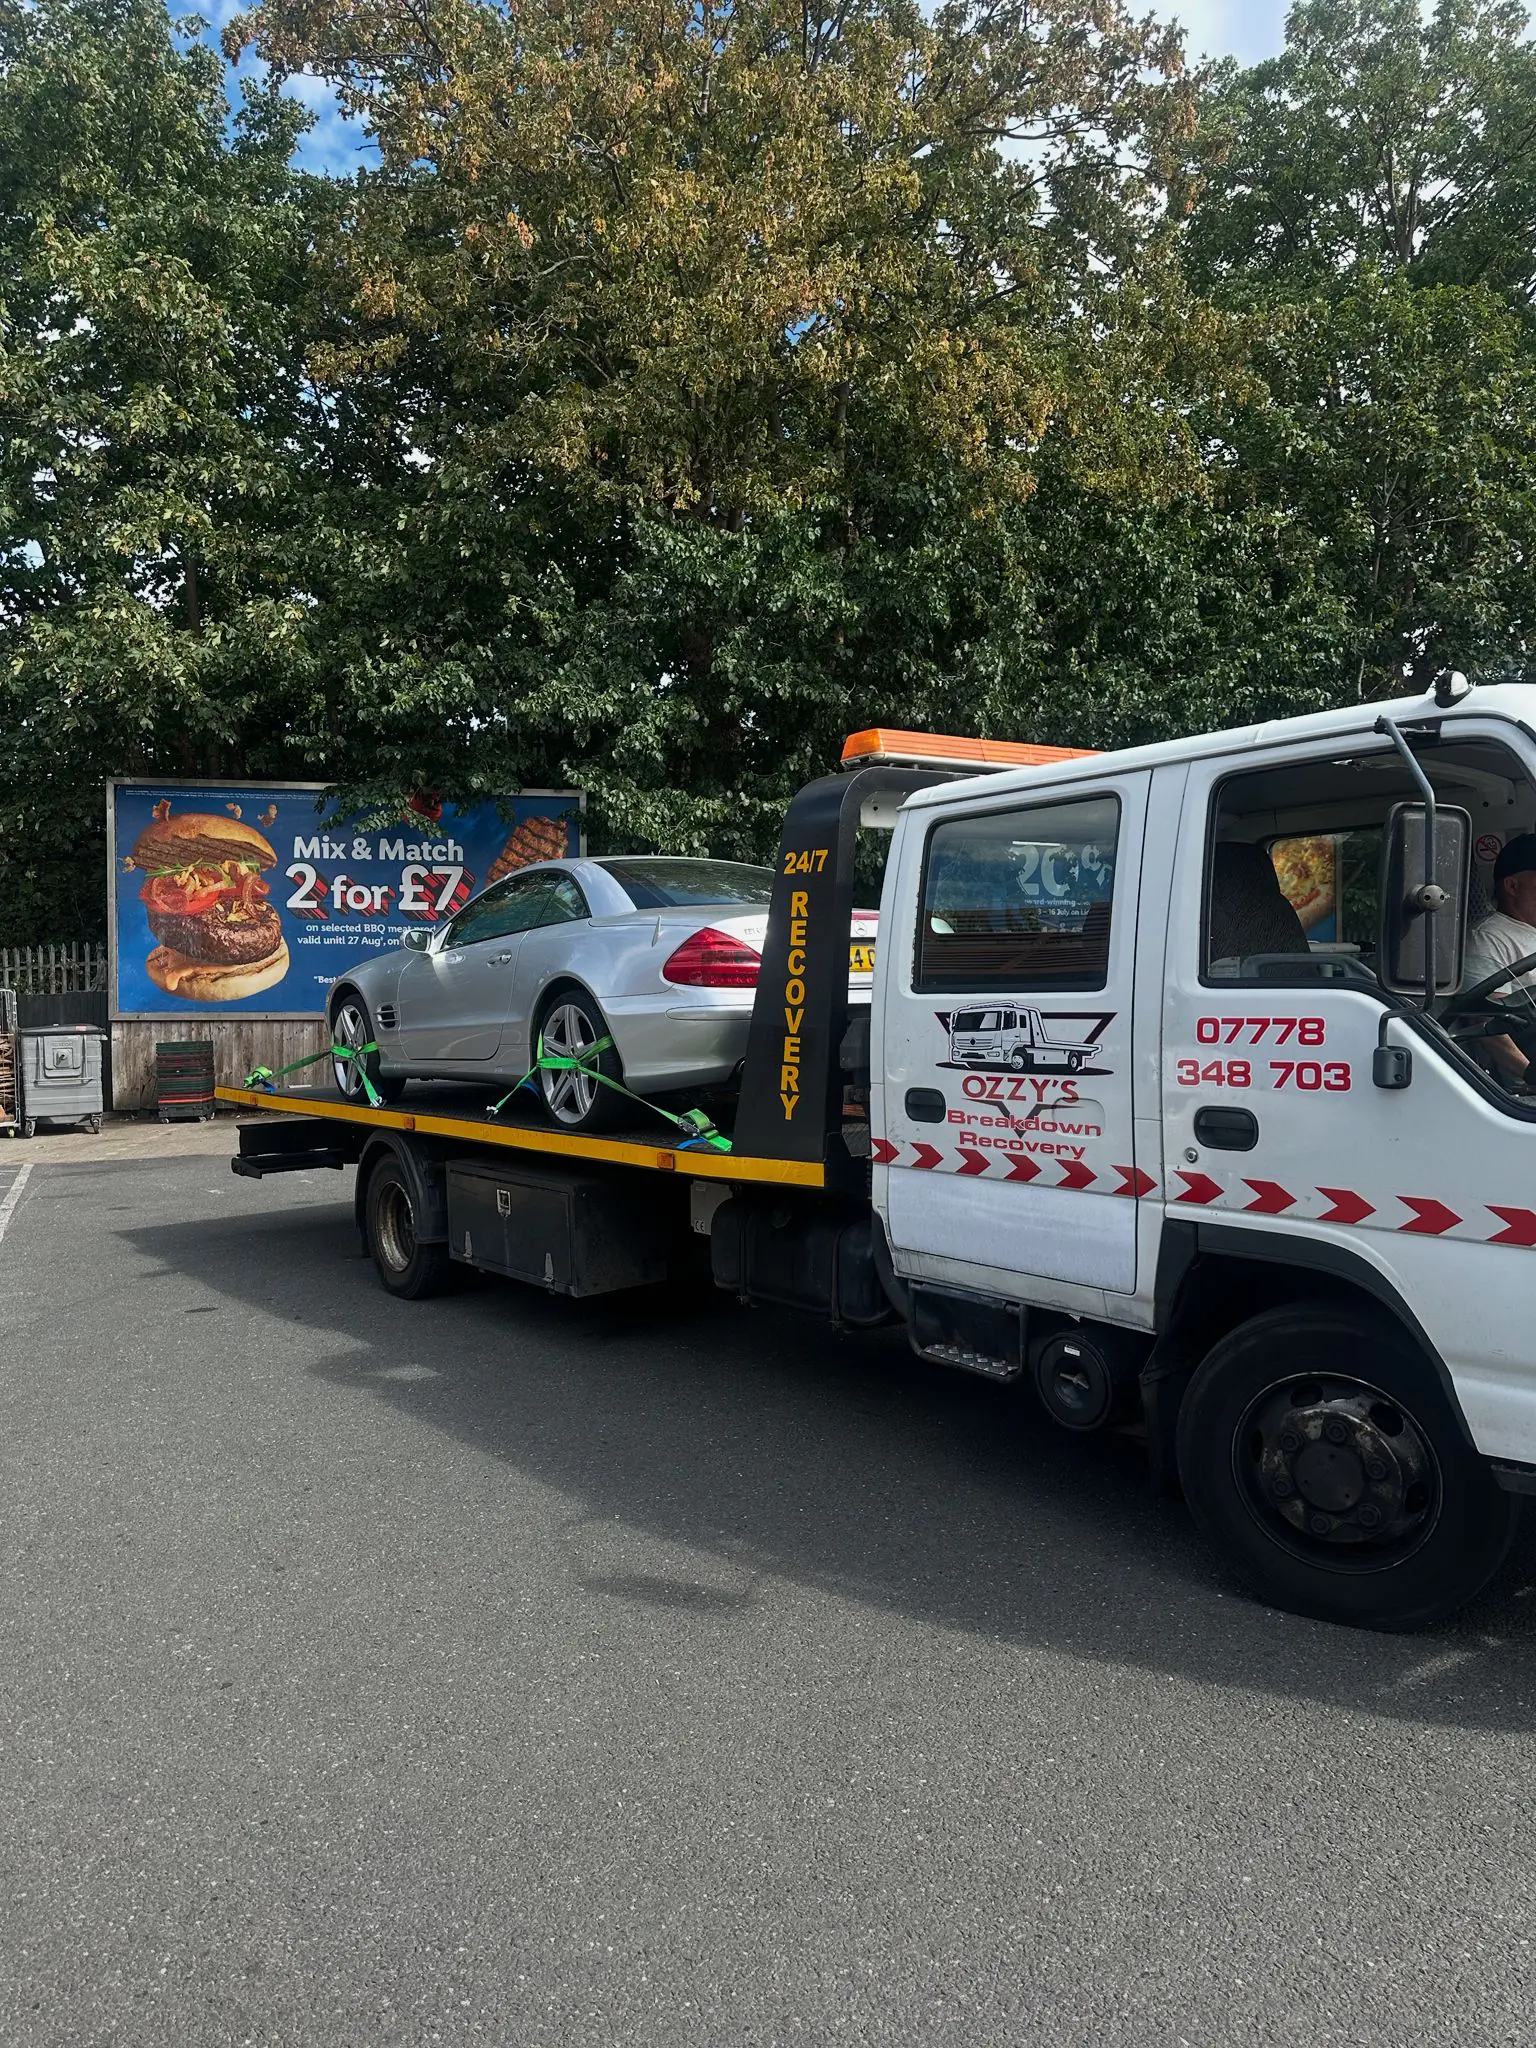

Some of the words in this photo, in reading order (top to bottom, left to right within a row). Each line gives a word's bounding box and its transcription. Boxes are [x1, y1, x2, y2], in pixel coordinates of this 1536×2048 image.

[293, 835, 347, 860] Mix
[351, 837, 373, 861] &
[379, 838, 464, 862] Match
[783, 849, 829, 875] 24/7
[284, 862, 318, 909] 2
[331, 874, 389, 910] for
[398, 863, 464, 911] £7
[297, 936, 321, 945] valid
[347, 936, 359, 945] 27
[387, 938, 400, 946] on
[305, 924, 319, 932] on
[321, 923, 361, 933] selected
[363, 924, 386, 935] BBQ
[779, 891, 809, 1121] RECOVERY
[1195, 1016, 1326, 1047] 07778
[962, 1074, 1080, 1104] OZZY'S
[1176, 1059, 1252, 1089] 348
[1268, 1060, 1353, 1092] 703
[946, 1108, 1102, 1137] Breakdown
[958, 1130, 1087, 1161] Recovery
